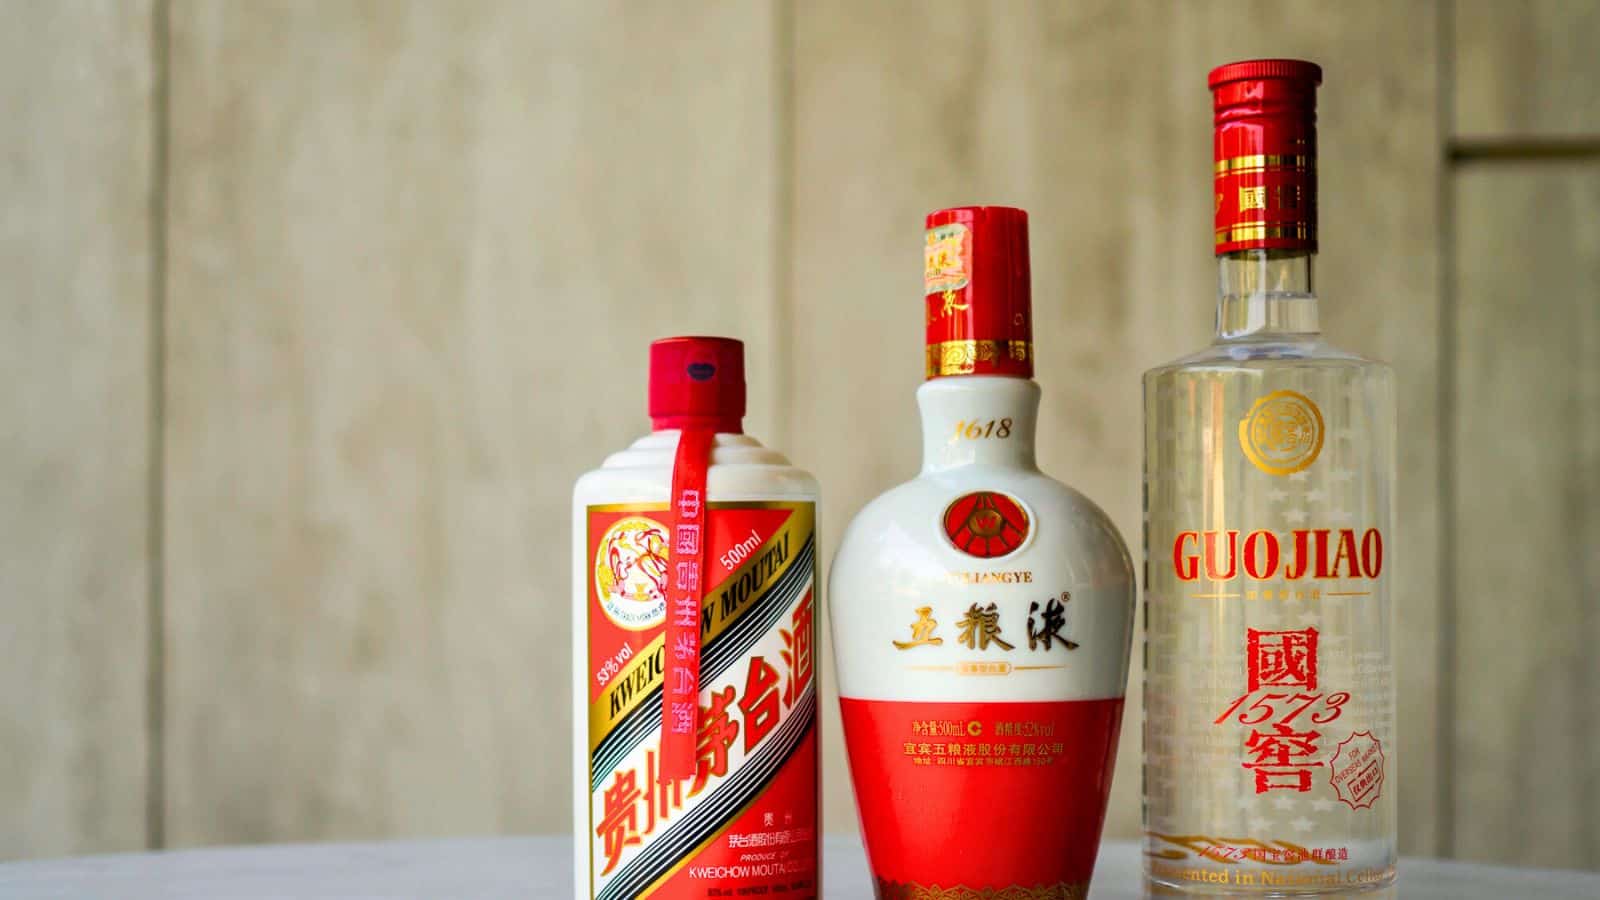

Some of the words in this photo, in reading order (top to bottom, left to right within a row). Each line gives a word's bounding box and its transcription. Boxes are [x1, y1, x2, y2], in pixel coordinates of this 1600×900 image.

[951, 417, 1013, 442] 1618
[720, 529, 762, 571] 500ml
[720, 531, 789, 622] MOUTAI
[892, 598, 1080, 652] 五粮液
[1213, 691, 1351, 725] 1573
[1242, 723, 1324, 795] 窖
[689, 865, 751, 879] KWEICHOW
